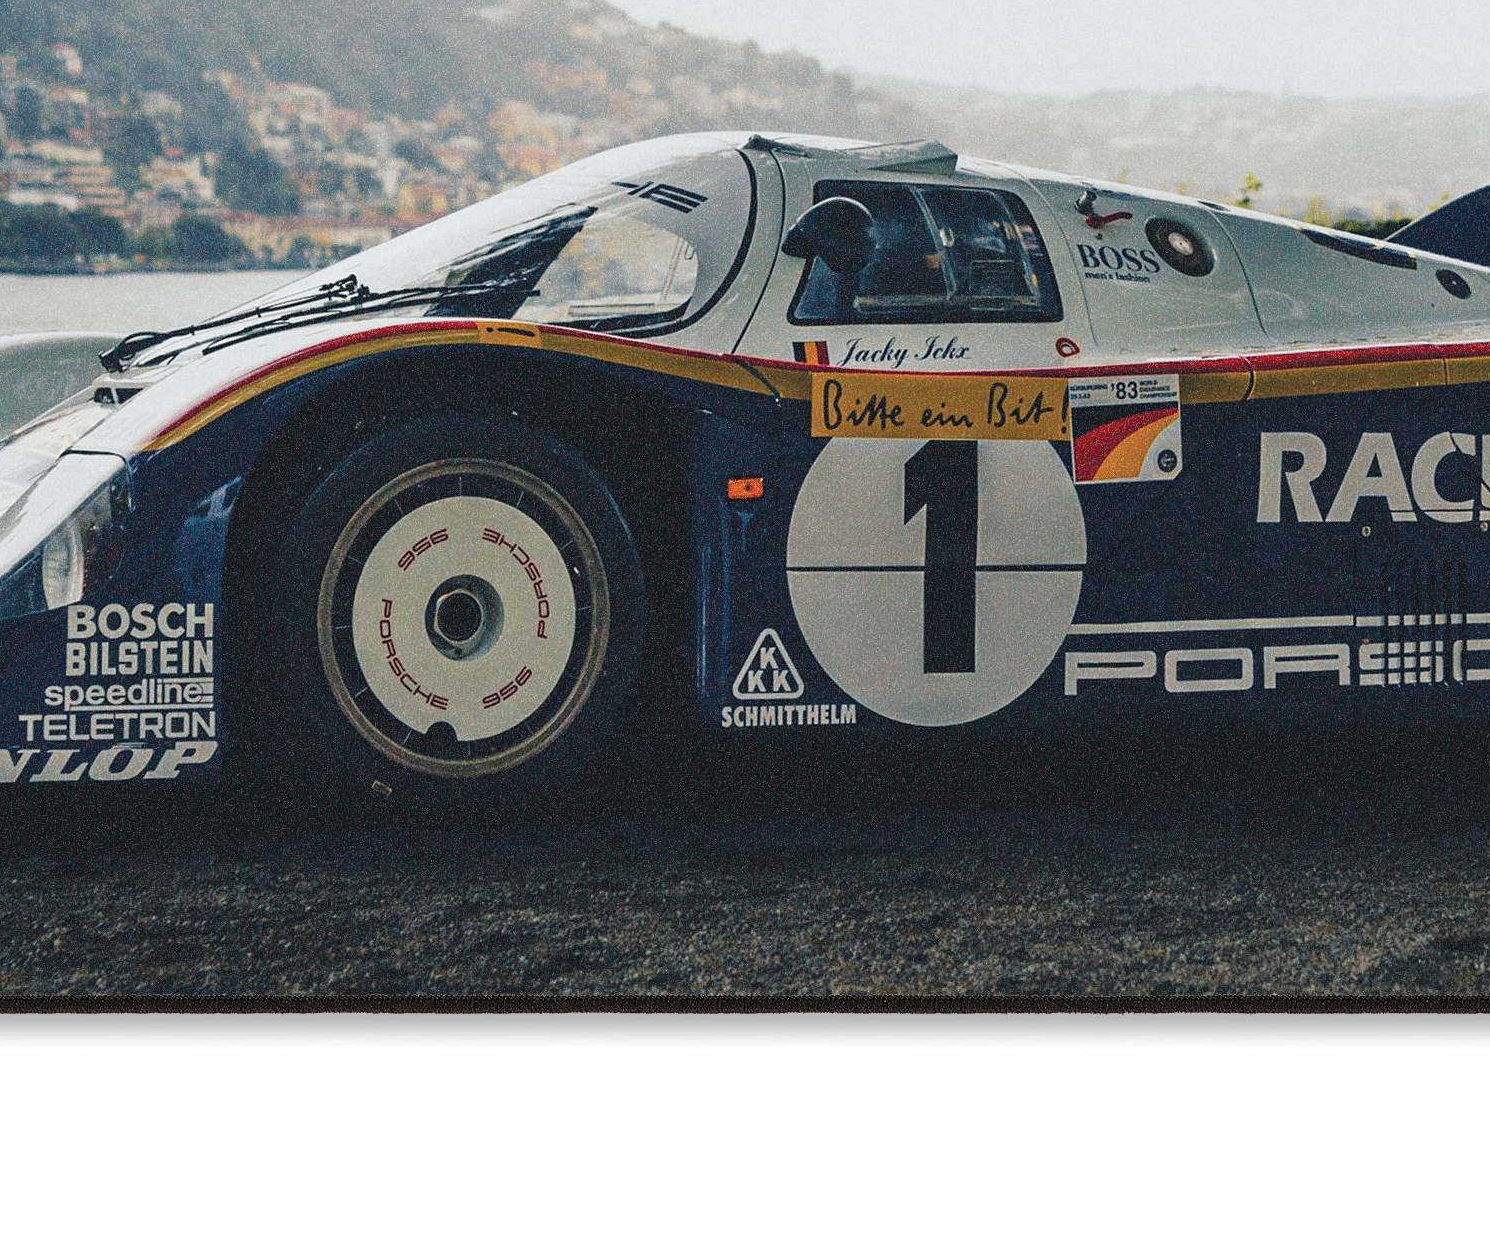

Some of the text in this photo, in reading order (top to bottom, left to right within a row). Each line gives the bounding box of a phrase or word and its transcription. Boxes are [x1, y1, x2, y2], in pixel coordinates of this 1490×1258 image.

[1077, 244, 1161, 273] BOSS
[836, 338, 909, 368] Jacky
[823, 380, 905, 430] Bitte
[920, 402, 973, 428] ein
[904, 440, 978, 673] 1
[482, 528, 550, 639] PORSCHE
[67, 603, 214, 639] BOSCH
[65, 640, 214, 677] BILSTEIN
[379, 598, 449, 710] PORSCHE
[44, 678, 207, 711] speedline
[482, 665, 532, 709] 956
[18, 711, 217, 742] TELETRON
[721, 704, 857, 728] SCHMITTHELM
